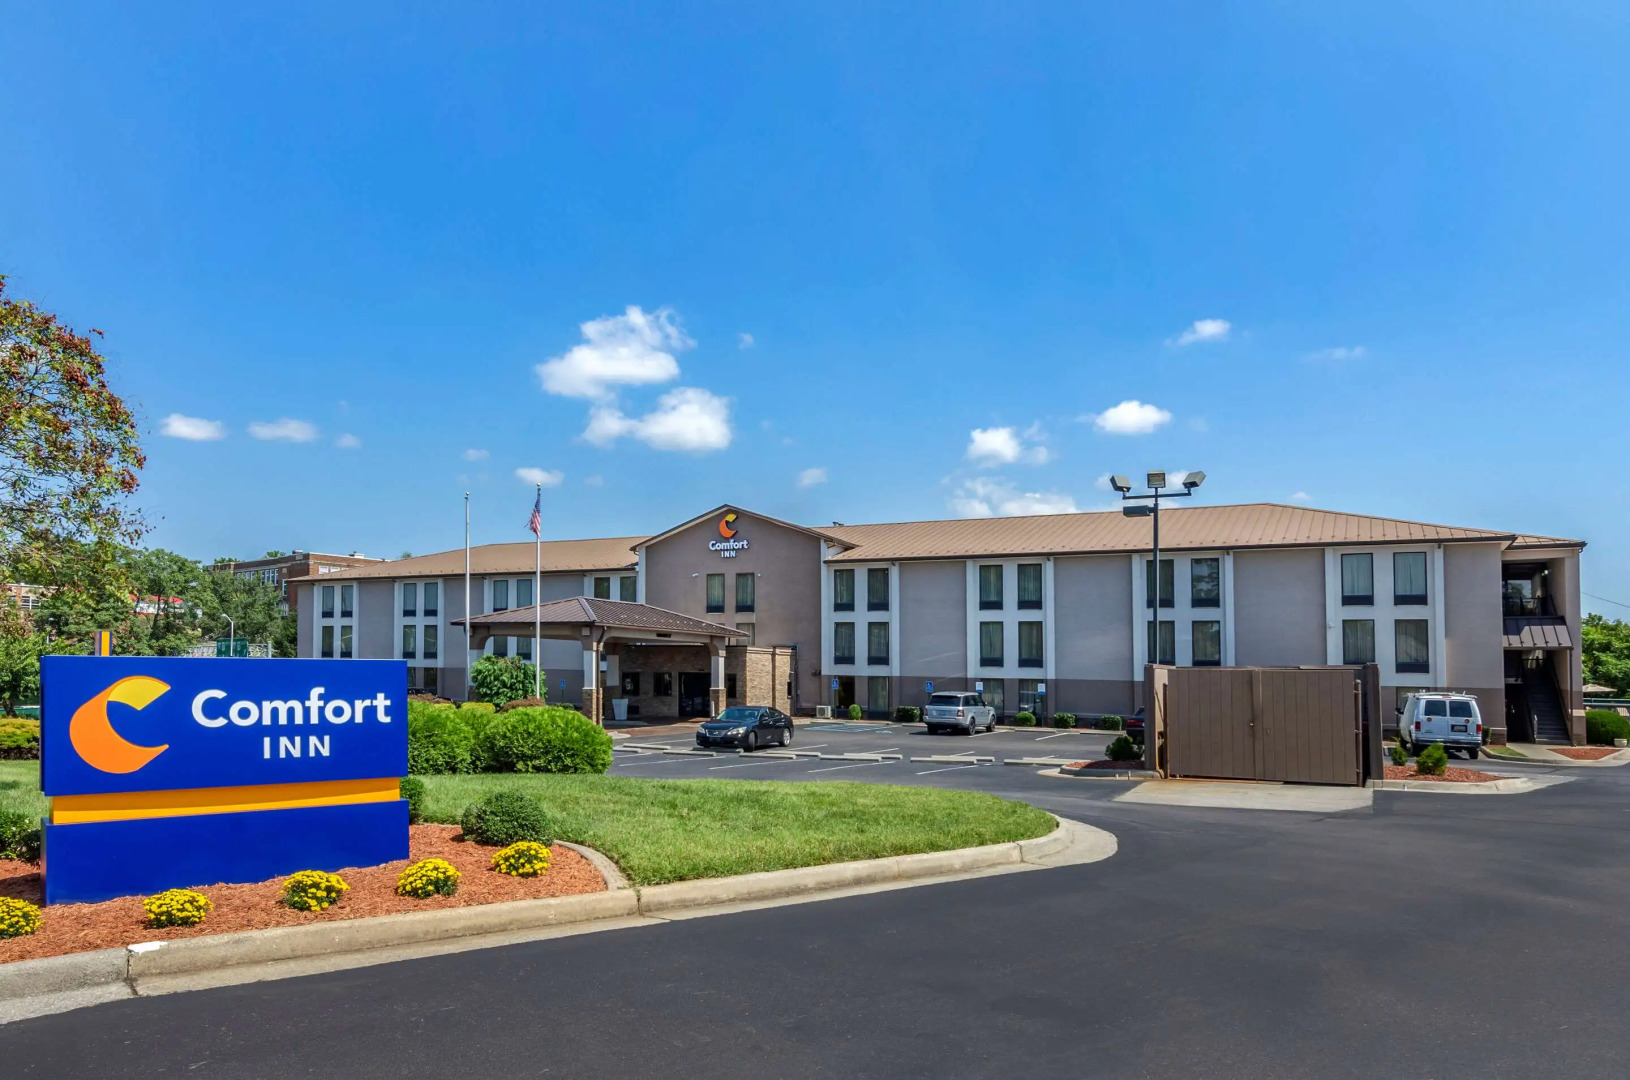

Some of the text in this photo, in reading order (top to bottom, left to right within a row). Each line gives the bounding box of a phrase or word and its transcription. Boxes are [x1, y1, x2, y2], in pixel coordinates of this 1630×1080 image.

[709, 539, 748, 550] Comfort
[721, 550, 736, 558] INN
[192, 687, 391, 728] Comfort
[263, 735, 331, 759] INN
